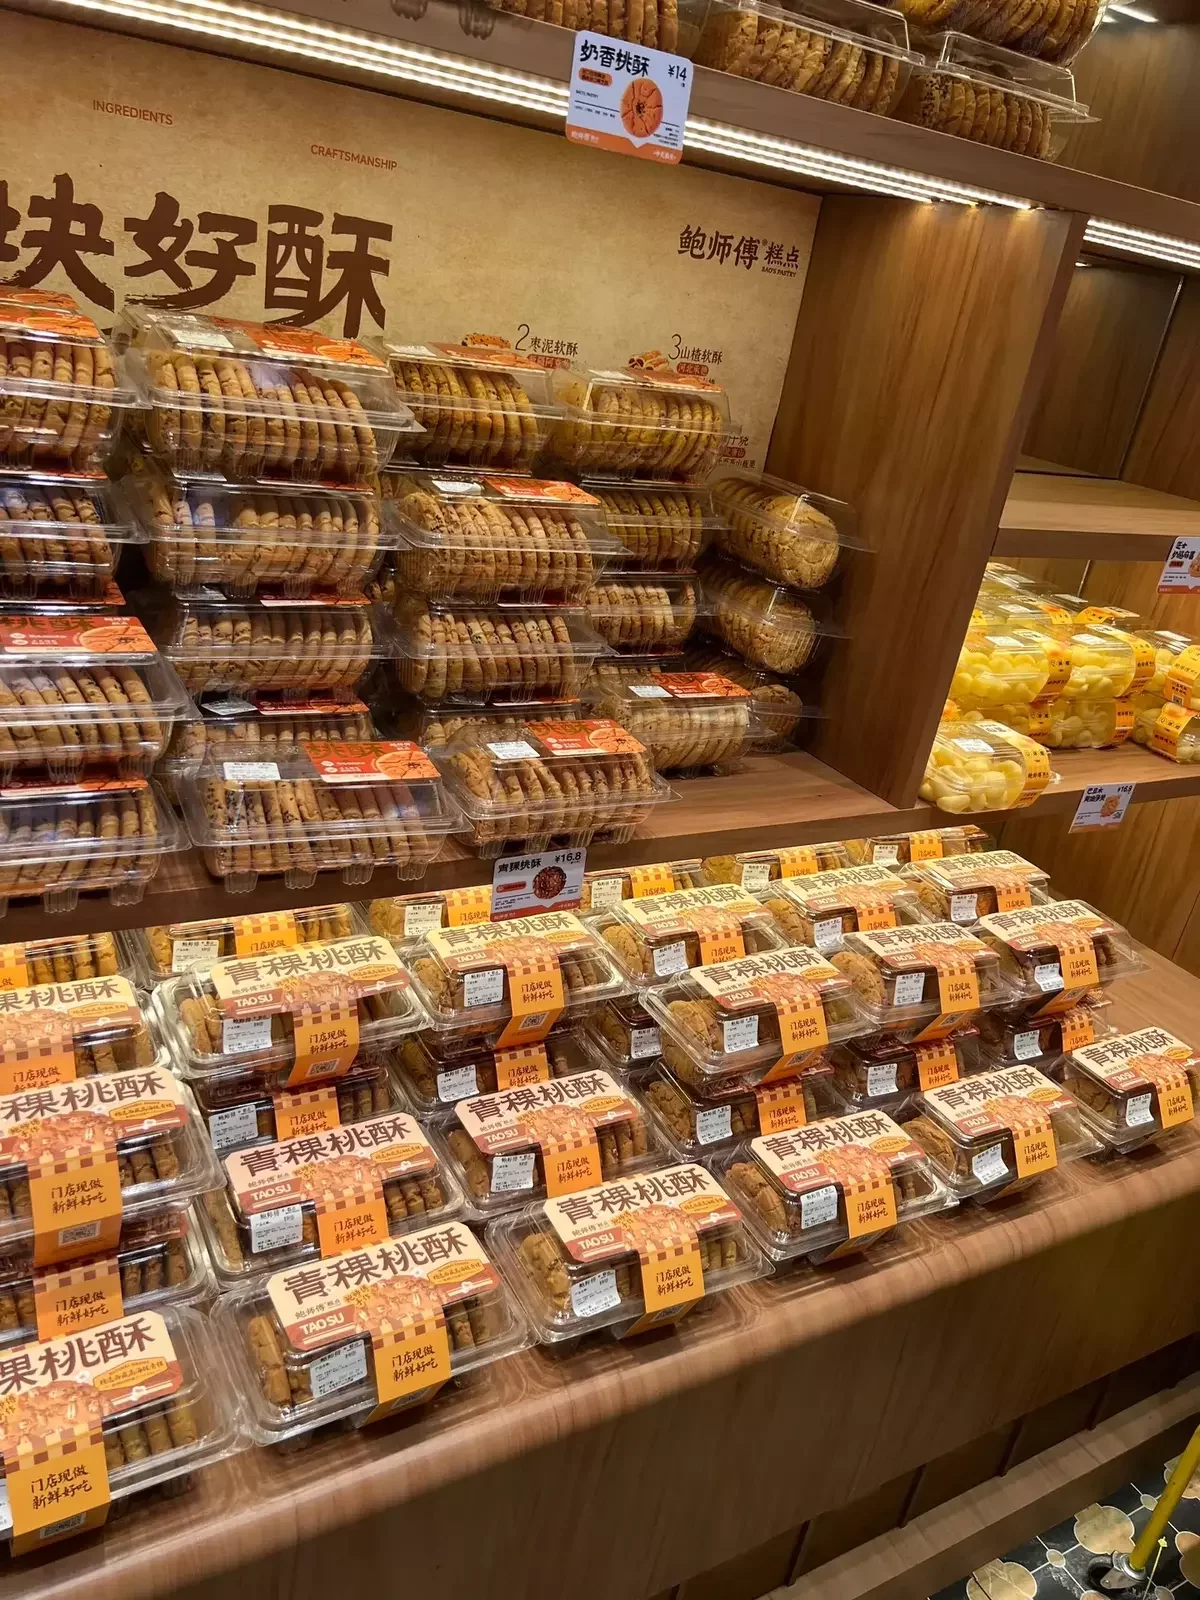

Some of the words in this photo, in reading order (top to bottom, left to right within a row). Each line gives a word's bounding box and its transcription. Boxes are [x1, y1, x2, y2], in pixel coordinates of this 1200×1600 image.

[580, 39, 650, 77] 奶香桃酥
[668, 65, 687, 81] ¥14
[92, 100, 173, 126] INGREDIENTS
[310, 144, 398, 171] CRAFTSMANSHIP
[761, 266, 777, 275] BAO'S
[777, 269, 797, 278] PASTRY
[529, 336, 579, 357] 枣泥软酥
[680, 346, 723, 365] 山楂软酥
[555, 851, 582, 863] ¥16.8
[936, 851, 1021, 873] 青稞桃酥
[791, 865, 890, 892] 青稞桃酥
[633, 885, 745, 915] 青稞桃酥
[988, 901, 1088, 930] 青稞桃酥
[438, 913, 575, 946] 青稞桃酥
[868, 923, 970, 948] 青稞桃酥
[250, 940, 287, 952] 门店现做
[224, 939, 388, 986] 青稞桃酥
[701, 949, 822, 985] 青稞桃酥
[521, 981, 553, 992] 门店现做
[790, 1017, 818, 1030] 门店现做
[309, 1029, 347, 1043] 门店现做
[1081, 1028, 1174, 1067] 青稞桃酥
[13, 1066, 61, 1082] 门店现做
[508, 1065, 539, 1077] 门店现做
[467, 1072, 610, 1123] 青稞桃酥
[934, 1067, 1044, 1109] 青稞桃酥
[289, 1110, 328, 1125] 门店现做
[769, 1105, 796, 1119] 门店现做
[240, 1116, 412, 1177] 青稞桃酥
[763, 1112, 891, 1161] 青稞桃酥
[556, 1158, 590, 1172] 门店现做
[51, 1178, 104, 1199] 门店现做
[556, 1167, 710, 1225] 青稞桃酥
[857, 1197, 886, 1212] 门店现做
[334, 1213, 375, 1231] 门店现做
[284, 1227, 468, 1305] 青稞桃酥
[656, 1264, 691, 1282] 门店现做
[55, 1290, 107, 1311] 门店现做
[57, 1304, 110, 1326] 新鲜好吃
[392, 1345, 436, 1367] 门店现做
[30, 1464, 89, 1493] 门店现做
[32, 1479, 93, 1510] 新鲜好吃
